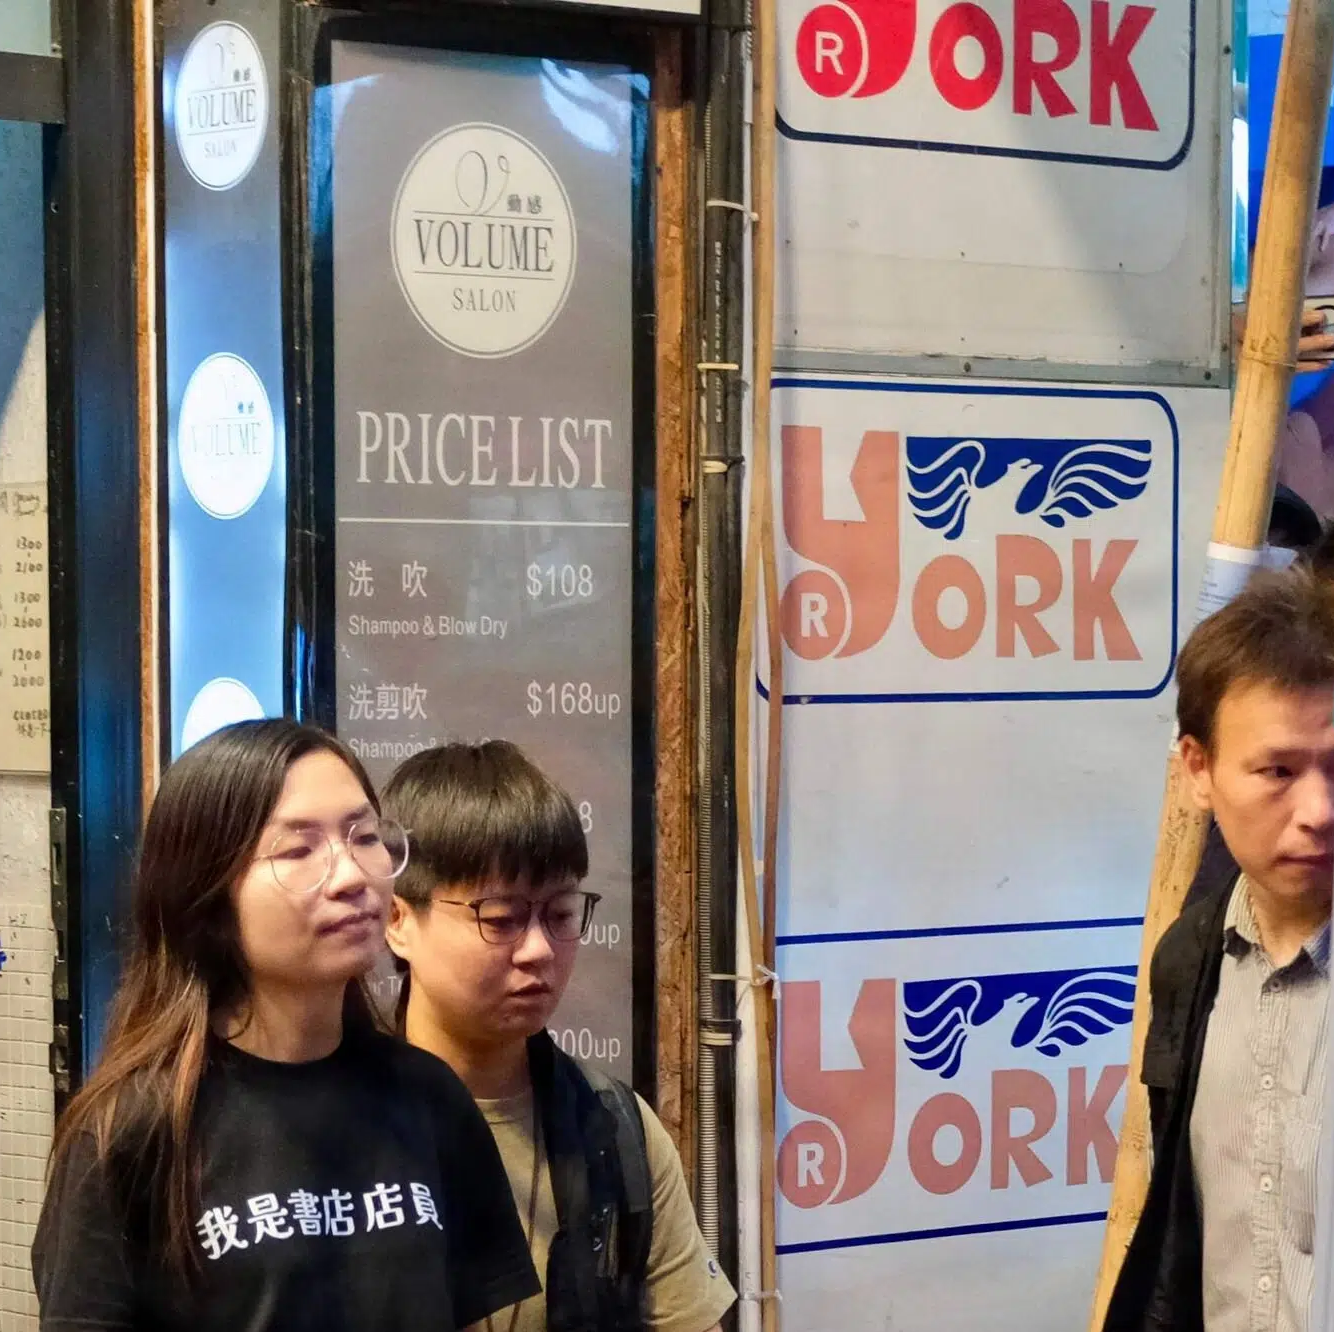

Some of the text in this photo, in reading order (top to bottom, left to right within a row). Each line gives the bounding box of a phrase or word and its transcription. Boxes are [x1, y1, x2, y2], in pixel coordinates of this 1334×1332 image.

[187, 88, 257, 129] VOLUME
[413, 219, 555, 273] VOLUME
[452, 287, 517, 313] SALON
[356, 410, 613, 489] PRICE LIST
[780, 425, 1144, 661] YORK
[525, 562, 594, 600] $108
[348, 615, 509, 641] Shampoo & Blow Dry
[348, 684, 428, 721] 洗剪吹
[526, 681, 621, 720] $168up
